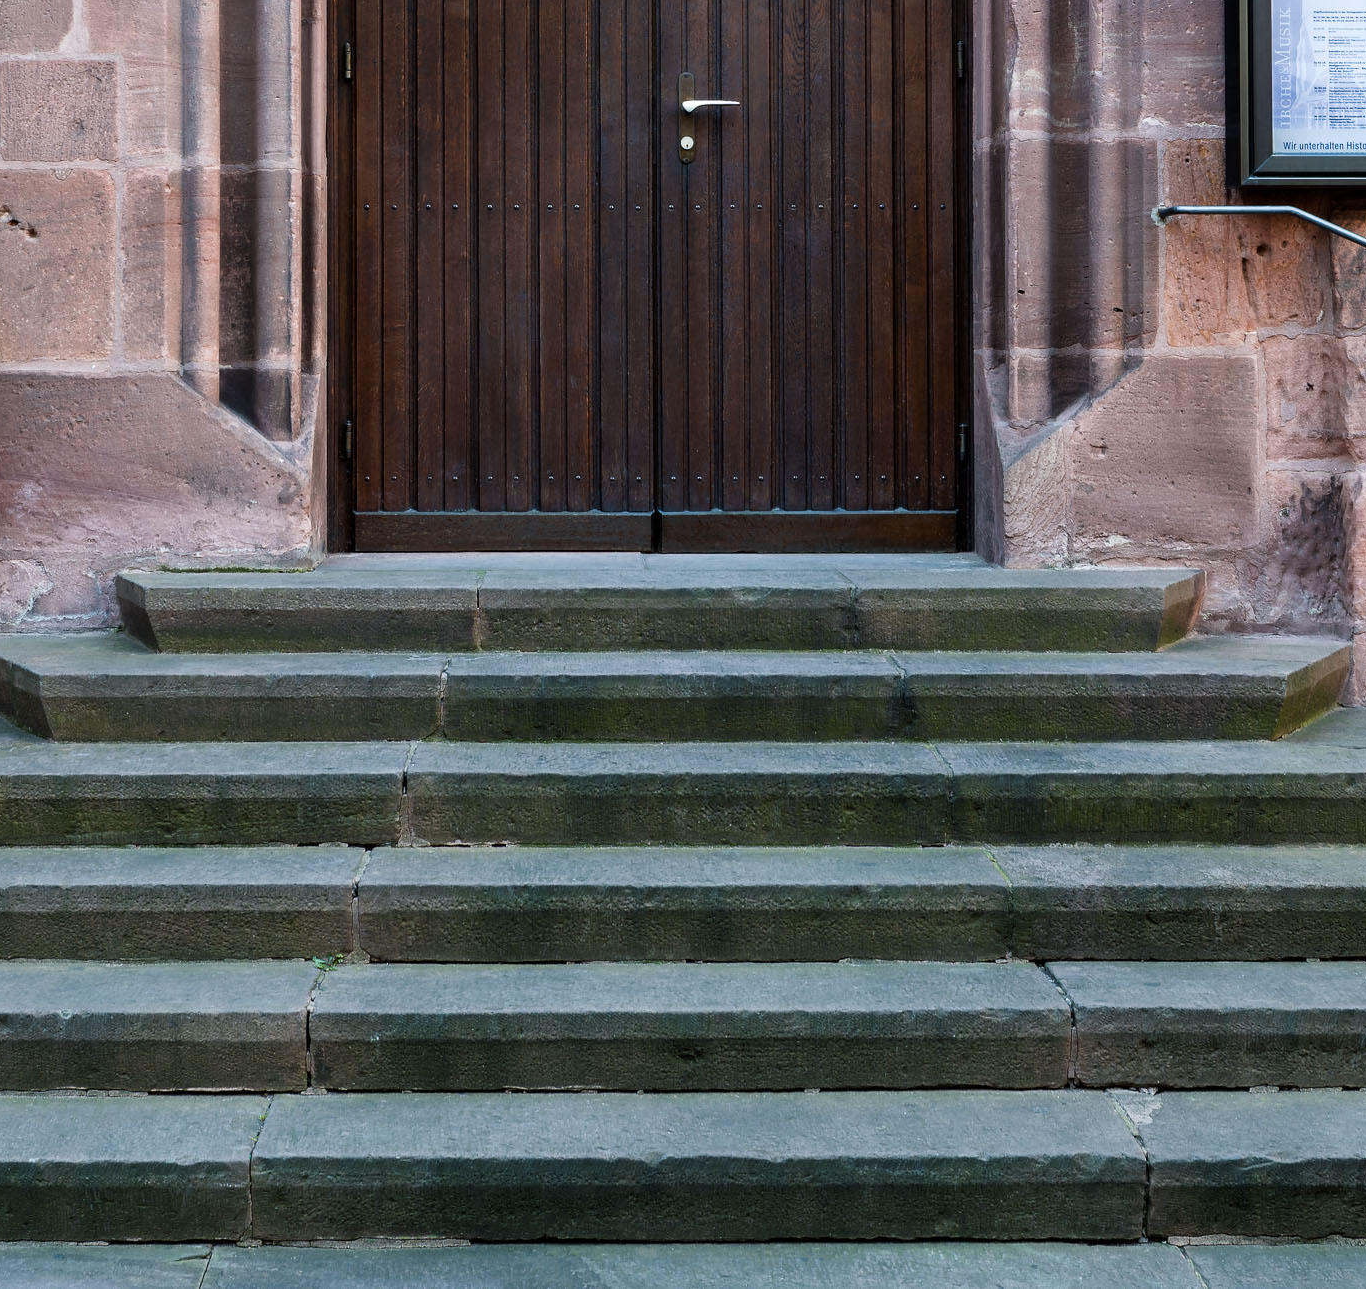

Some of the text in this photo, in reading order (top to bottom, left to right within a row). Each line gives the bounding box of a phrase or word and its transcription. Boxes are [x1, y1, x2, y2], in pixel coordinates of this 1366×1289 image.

[1275, 7, 1291, 128] IRCHE&MUSIK
[1283, 142, 1297, 150] Wir
[1299, 141, 1344, 150] unterhalten
